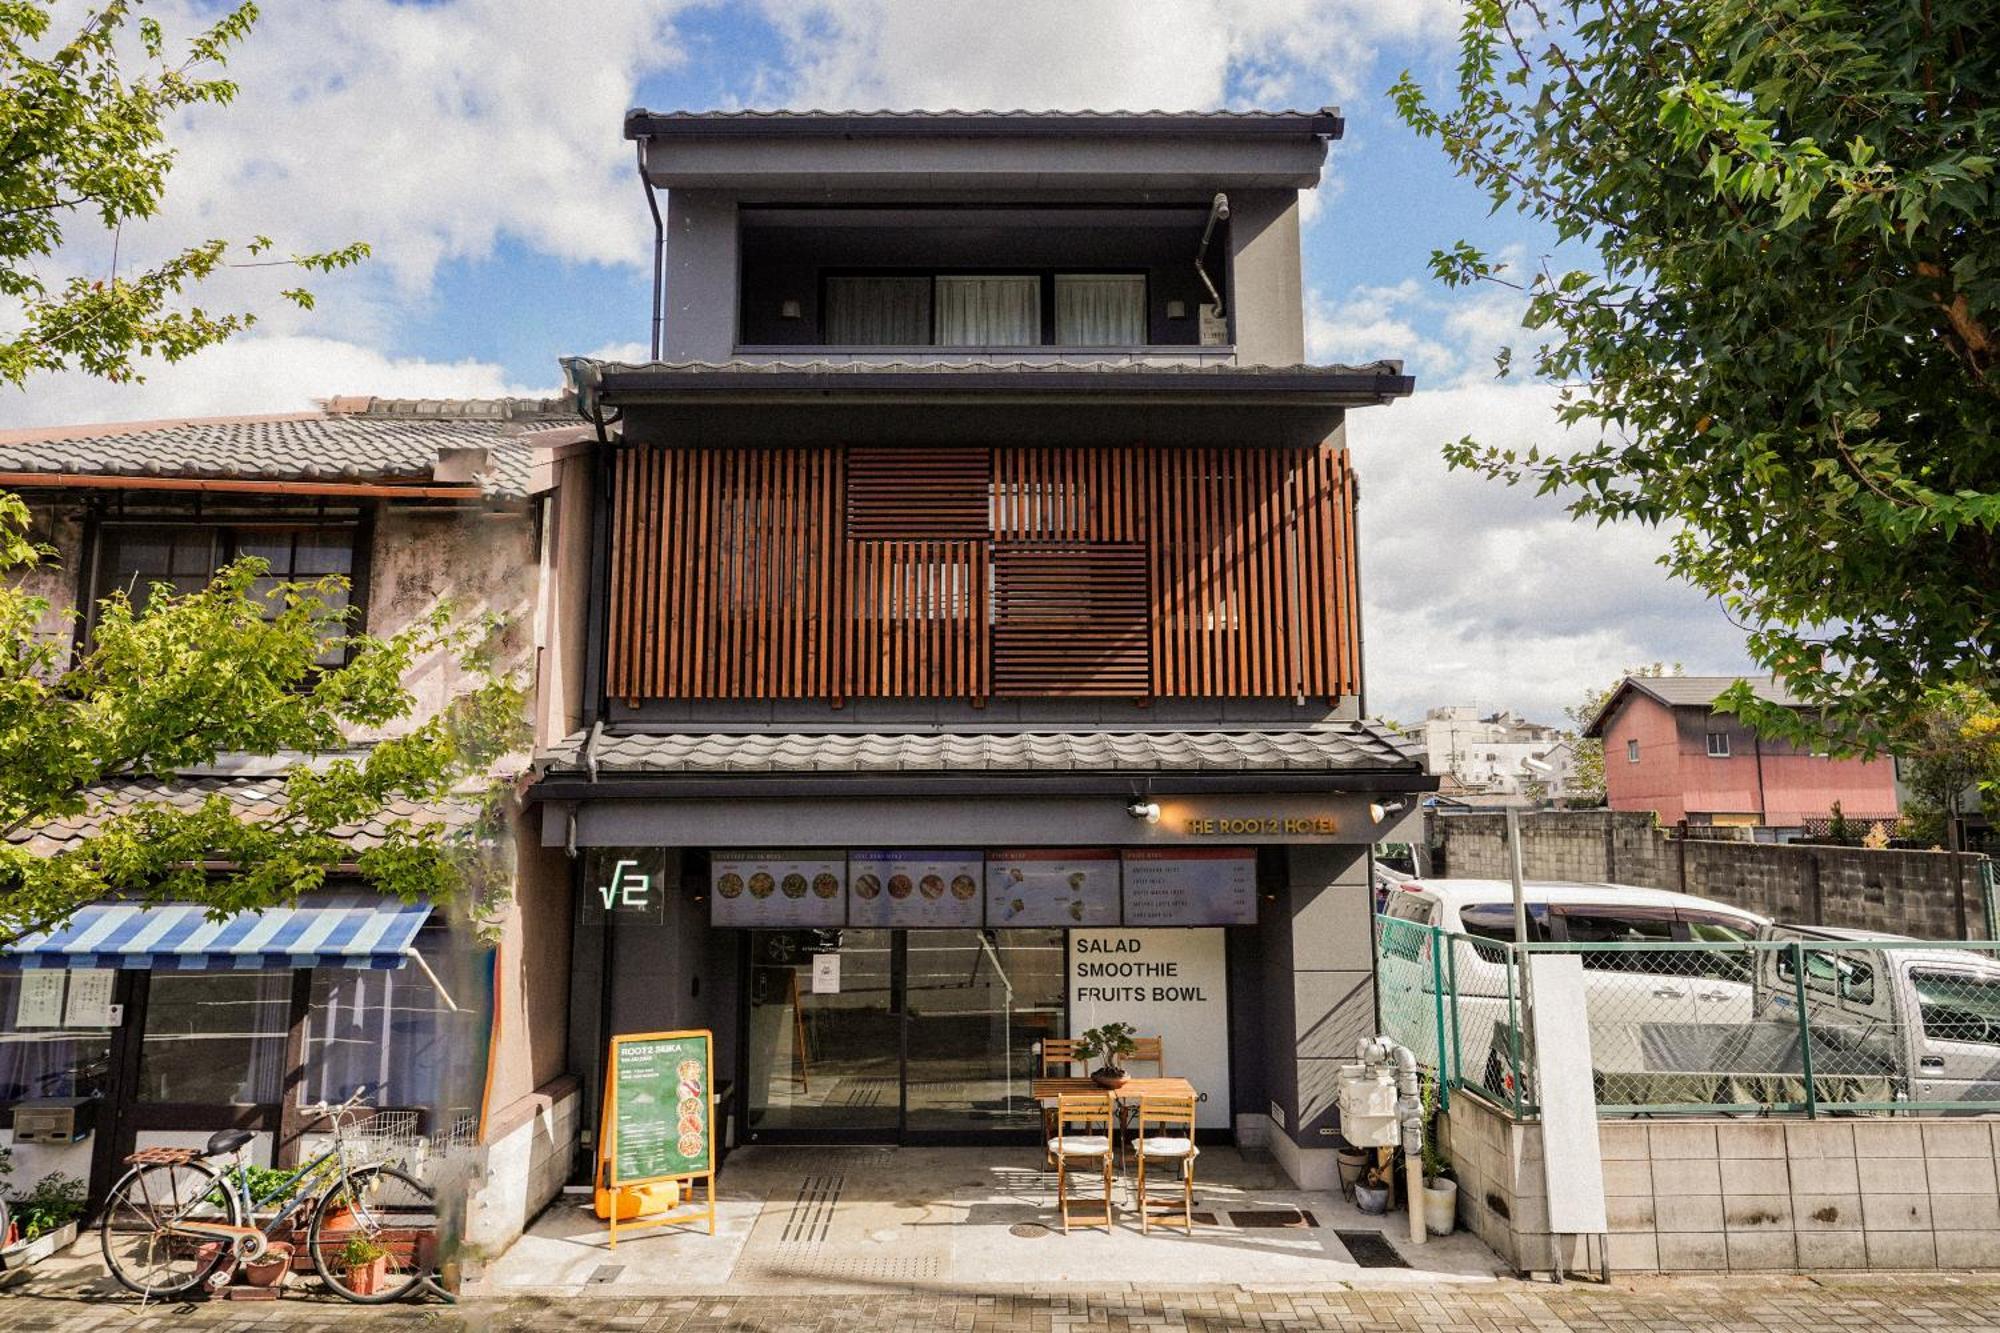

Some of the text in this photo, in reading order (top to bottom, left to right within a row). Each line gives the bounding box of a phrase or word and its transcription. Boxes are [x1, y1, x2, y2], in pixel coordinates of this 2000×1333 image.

[1077, 938, 1141, 953] SALAD
[1077, 962, 1178, 977] SMOOTHIE
[1077, 987, 1207, 1001] FRUITS BOWL
